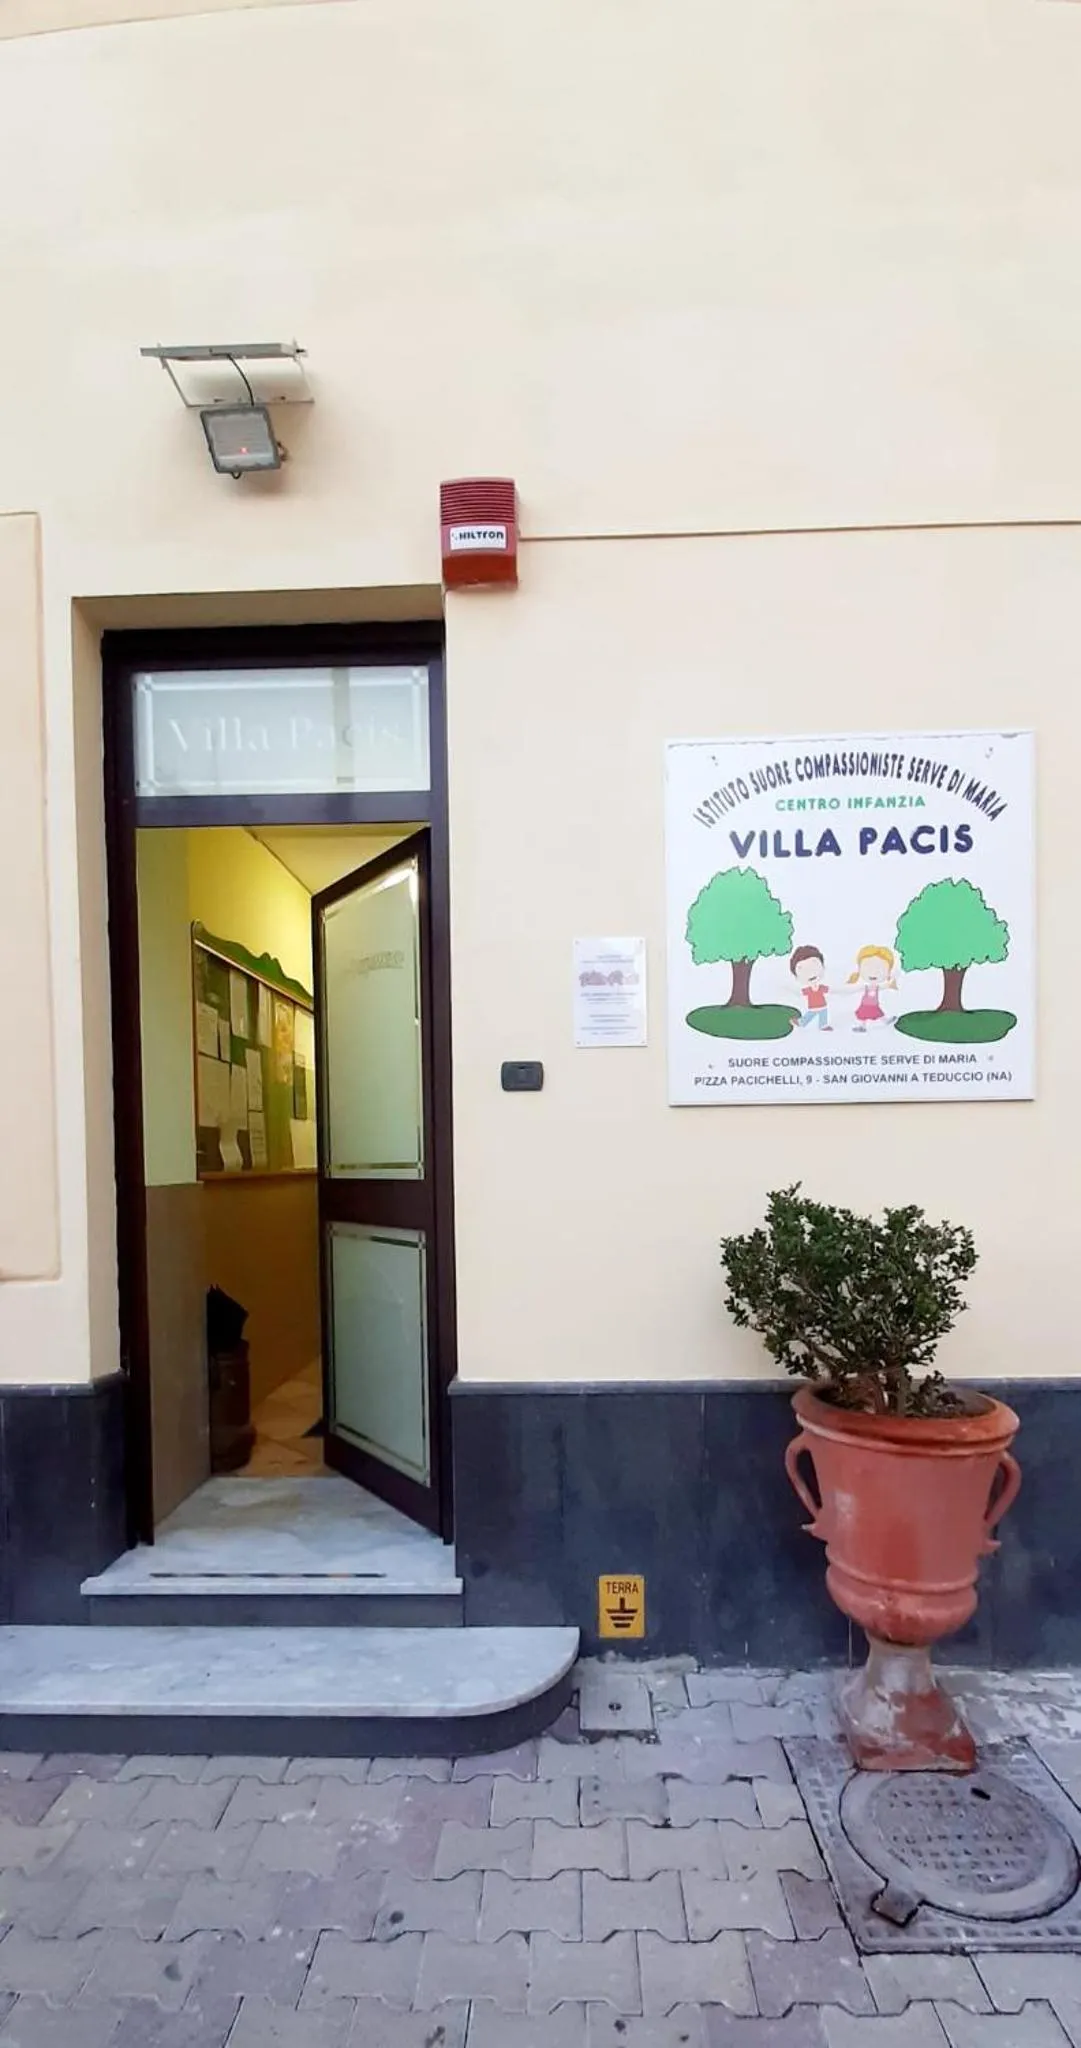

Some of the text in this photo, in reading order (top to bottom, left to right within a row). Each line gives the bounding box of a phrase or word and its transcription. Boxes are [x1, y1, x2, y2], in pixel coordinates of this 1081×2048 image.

[168, 714, 405, 752] Villa Pacis
[693, 751, 1008, 829] ISTITUTO SUORE COMPASSIONISTE SERVE DI MARIA
[775, 795, 926, 811] CENTRO INFANZIA
[729, 824, 974, 859] VILLA PACIS
[728, 1053, 978, 1068] SUORE COMPASSIONISTE SERVE DI MARIA
[694, 1075, 727, 1087] PIZZA
[731, 1075, 804, 1086] PACICHELLI,
[805, 1074, 813, 1085] 9
[823, 1074, 848, 1085] SAN
[851, 1073, 908, 1084] GIOVANNI
[910, 1073, 919, 1083] A
[922, 1071, 984, 1082] TEDUCCIO
[986, 1071, 1013, 1083] (NA)
[605, 1581, 639, 1594] TERRA
